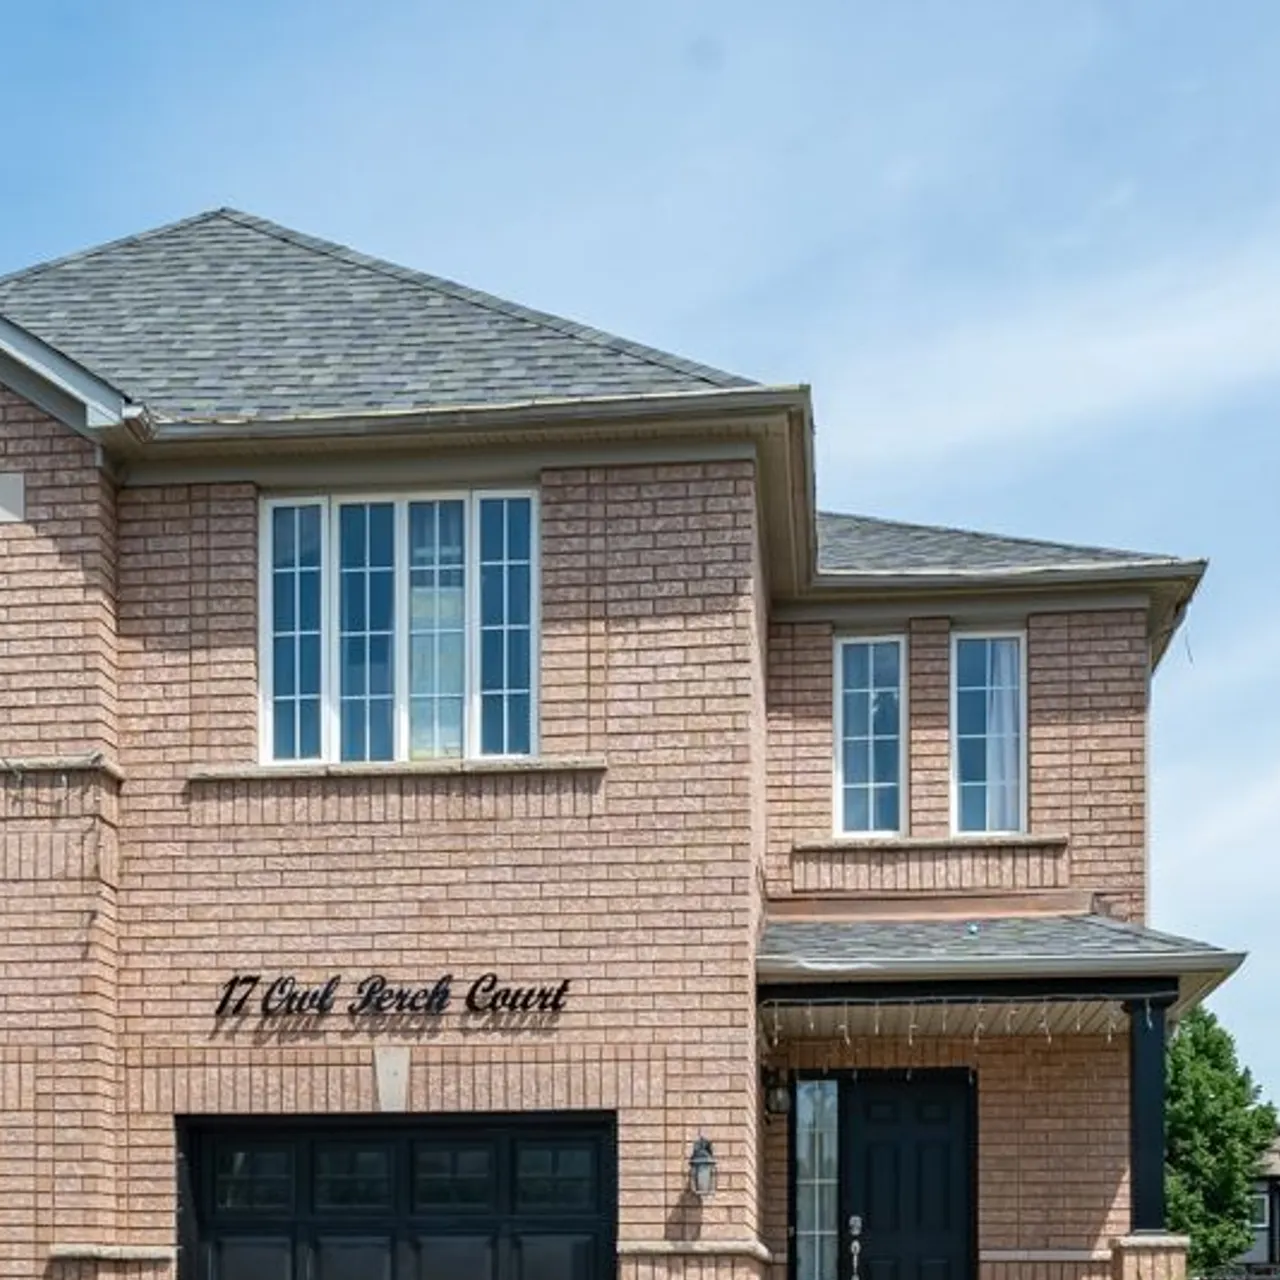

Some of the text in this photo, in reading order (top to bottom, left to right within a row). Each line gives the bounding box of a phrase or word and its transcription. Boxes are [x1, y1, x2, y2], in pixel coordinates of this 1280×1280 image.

[215, 972, 570, 1017] 17 Owl Perch Court
